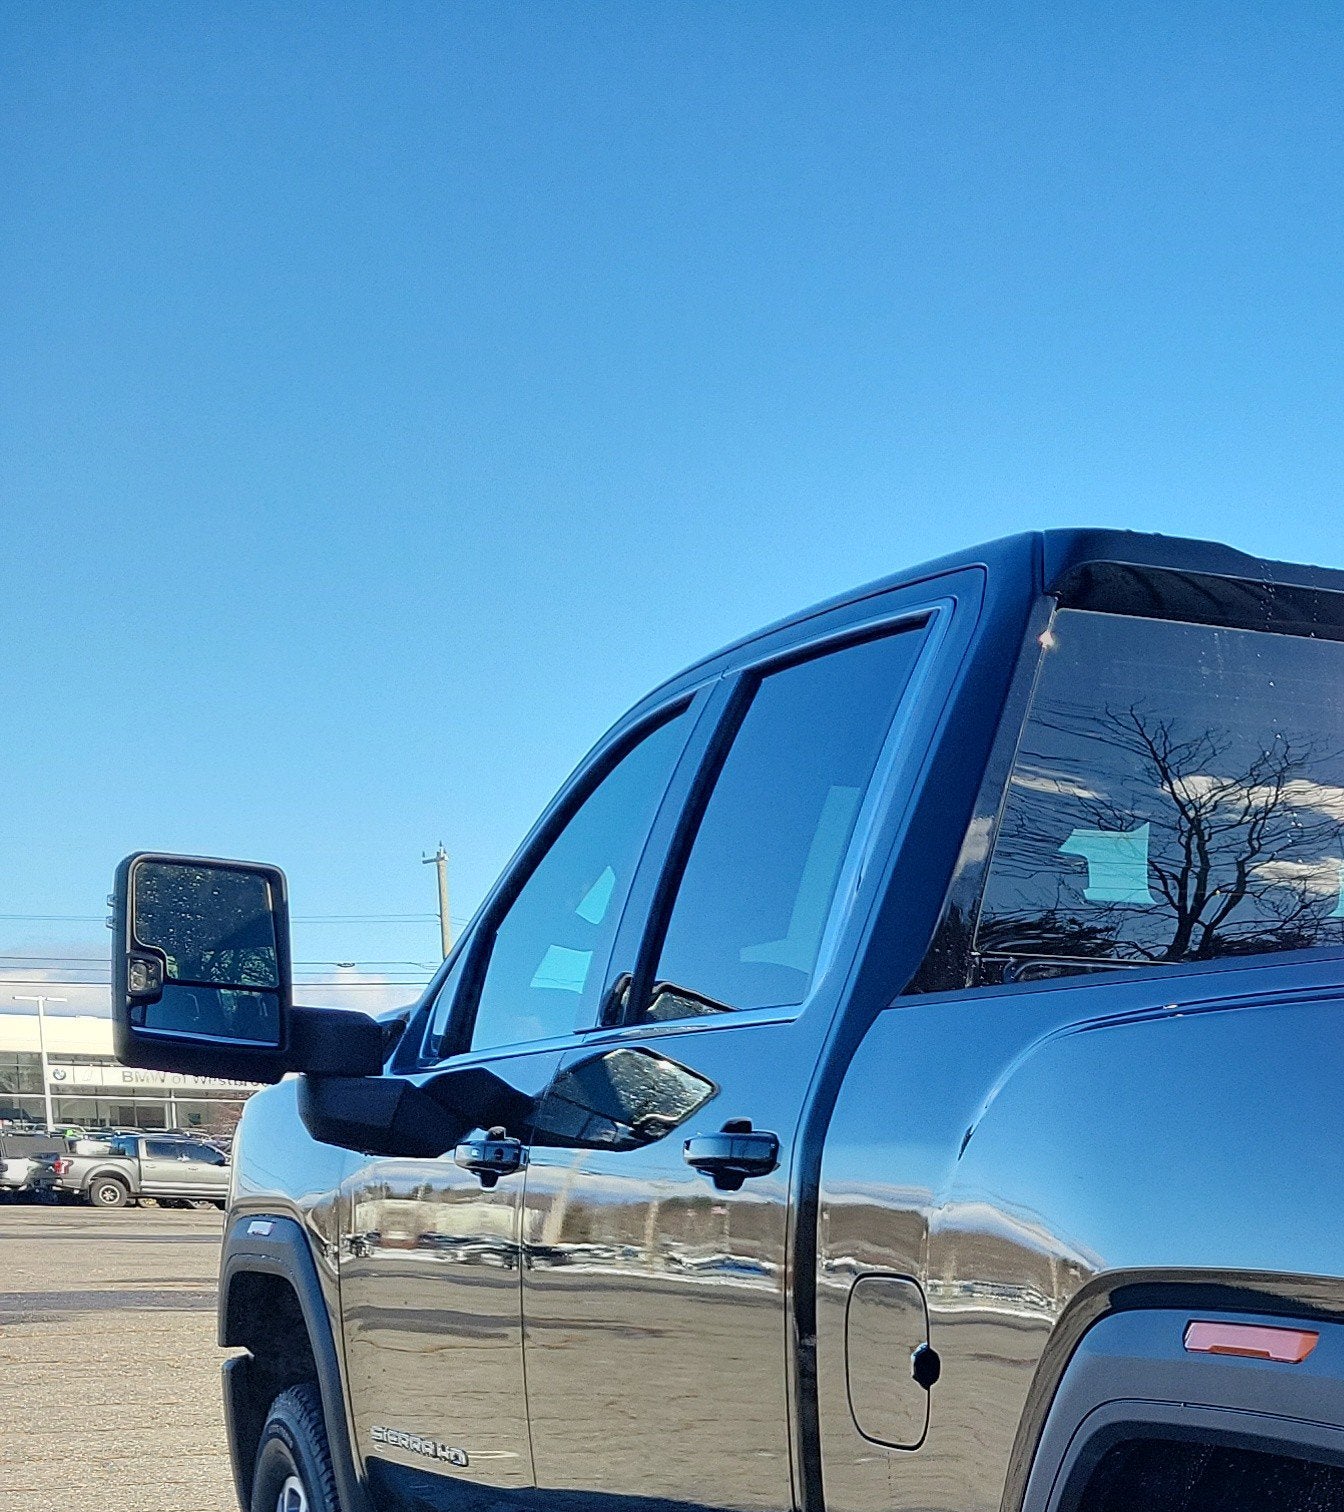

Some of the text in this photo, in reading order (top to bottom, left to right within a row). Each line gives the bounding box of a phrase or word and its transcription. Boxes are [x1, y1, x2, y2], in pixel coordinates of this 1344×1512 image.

[122, 1071, 166, 1083] BMW
[370, 1426, 469, 1467] SIERRA HD
